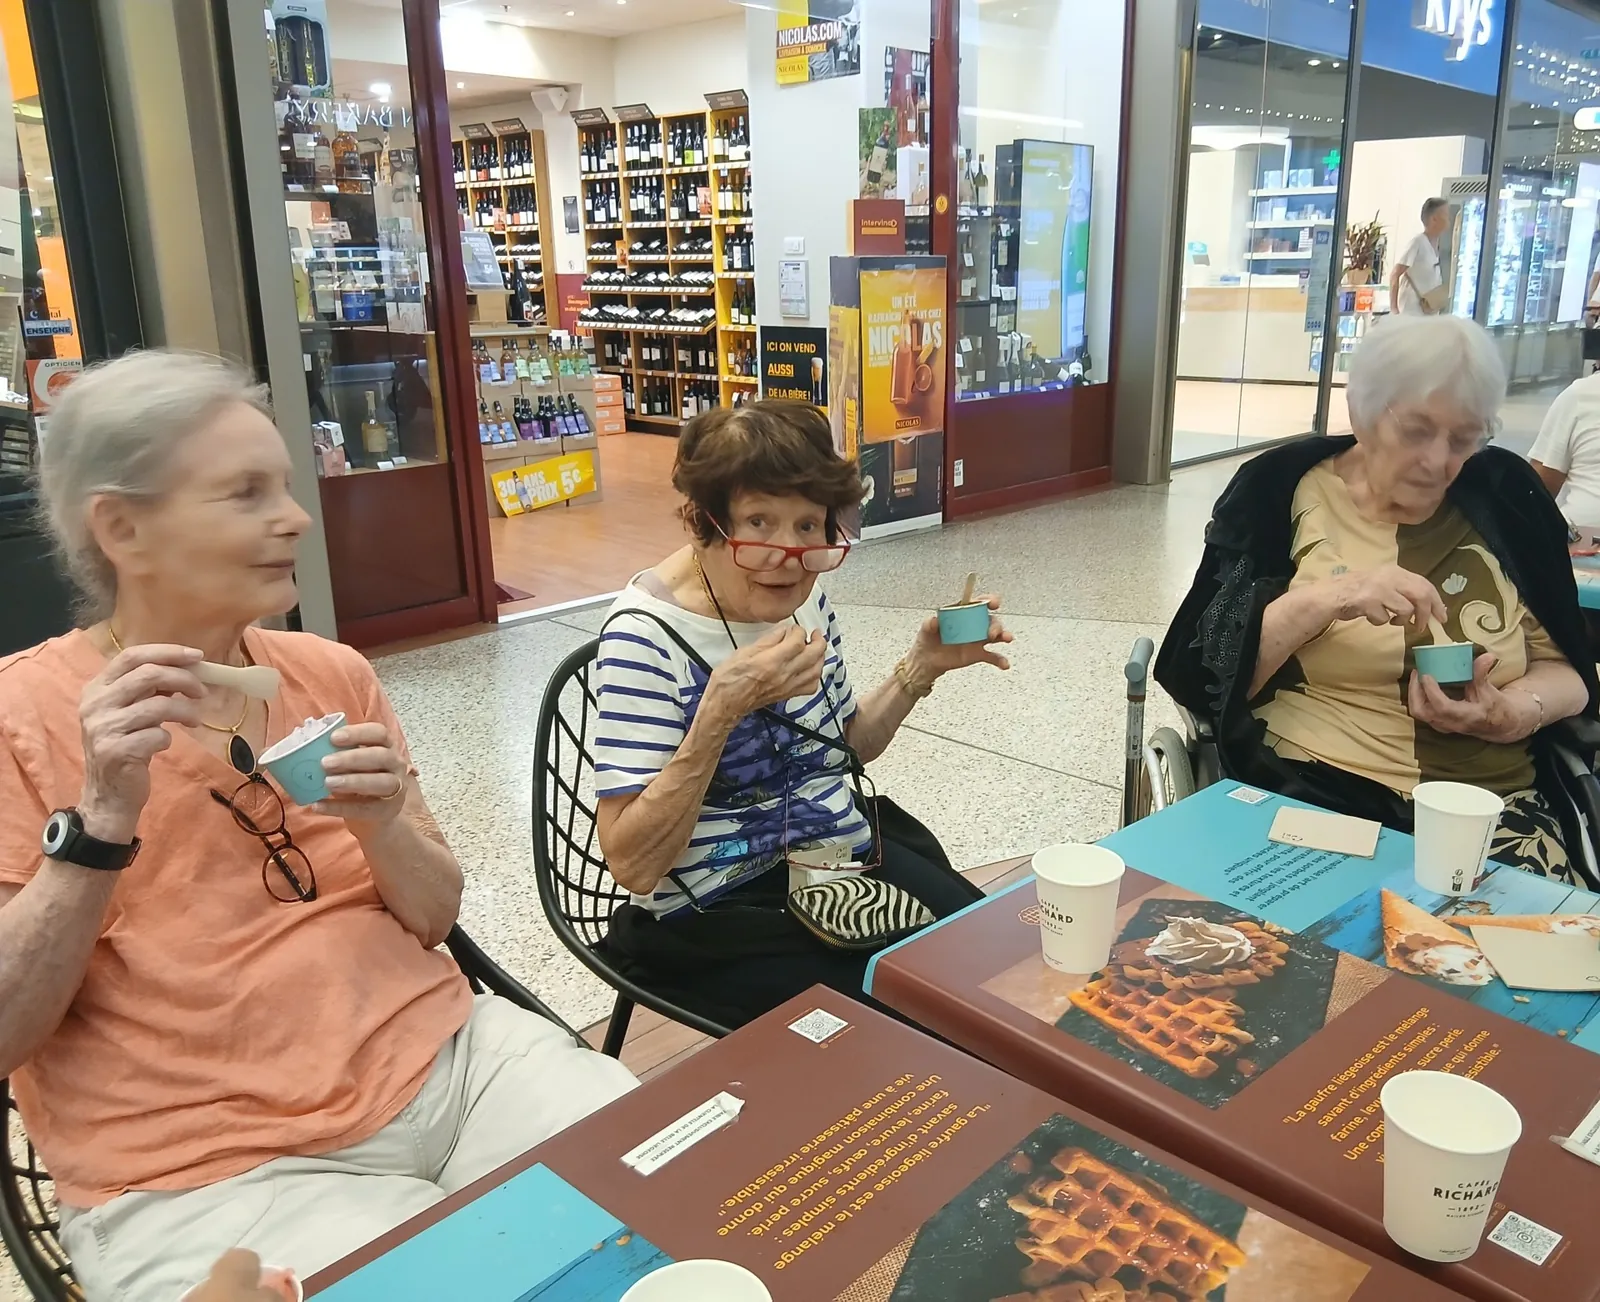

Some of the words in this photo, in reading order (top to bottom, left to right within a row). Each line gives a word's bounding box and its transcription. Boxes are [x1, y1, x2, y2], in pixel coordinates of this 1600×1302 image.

[779, 21, 842, 47] NICOLAS.COM
[778, 64, 804, 73] NICOLAS
[26, 326, 72, 335] ENSEIGNE
[868, 321, 942, 356] NICOLAS
[766, 341, 778, 351] ICI
[779, 341, 792, 352] ON
[794, 343, 816, 353] VEND
[768, 363, 794, 376] AUSSI
[768, 387, 778, 398] DE
[779, 388, 787, 398] LA
[788, 387, 807, 400] BIÈRE
[896, 418, 919, 428] NICOLAS
[527, 481, 560, 505] PRIX
[1303, 1084, 1338, 1112] gaufre
[1331, 1051, 1375, 1086] liégeoise
[1372, 1040, 1389, 1054] est
[1387, 1032, 1398, 1042] le
[1394, 1006, 1430, 1035] mélange
[884, 1085, 897, 1093] à
[894, 1073, 915, 1087] vie
[915, 1074, 942, 1092] Une
[1317, 1098, 1353, 1127] savant
[1349, 1051, 1407, 1100] d'ingrédients
[1403, 1026, 1437, 1053] simples
[1330, 1114, 1369, 1143] farine,
[1417, 1045, 1442, 1068] sucre
[1439, 1027, 1465, 1049] perlé.
[862, 1092, 886, 1109] une
[907, 1090, 949, 1116] farine,
[1343, 1141, 1369, 1160] Une
[1451, 1049, 1468, 1063] qui
[1463, 1030, 1491, 1052] donne
[799, 1107, 863, 1154] pâtisserie
[843, 1091, 916, 1144] combinaison
[866, 1117, 913, 1146] levure,
[917, 1103, 958, 1134] savant
[928, 1117, 968, 1149] gaufre
[787, 1143, 844, 1185] magique
[827, 1148, 868, 1175] œufs,
[835, 1133, 918, 1197] d'ingrédients
[873, 1148, 933, 1191] liégeoise
[718, 1153, 803, 1216] irrésistible."
[763, 1184, 788, 1204] qui
[790, 1177, 829, 1206] sucre
[849, 1191, 874, 1211] est
[717, 1202, 764, 1236] donne
[747, 1205, 791, 1236] perlé.
[782, 1195, 837, 1238] simples
[835, 1210, 853, 1222] le
[773, 1221, 836, 1270] mélange
